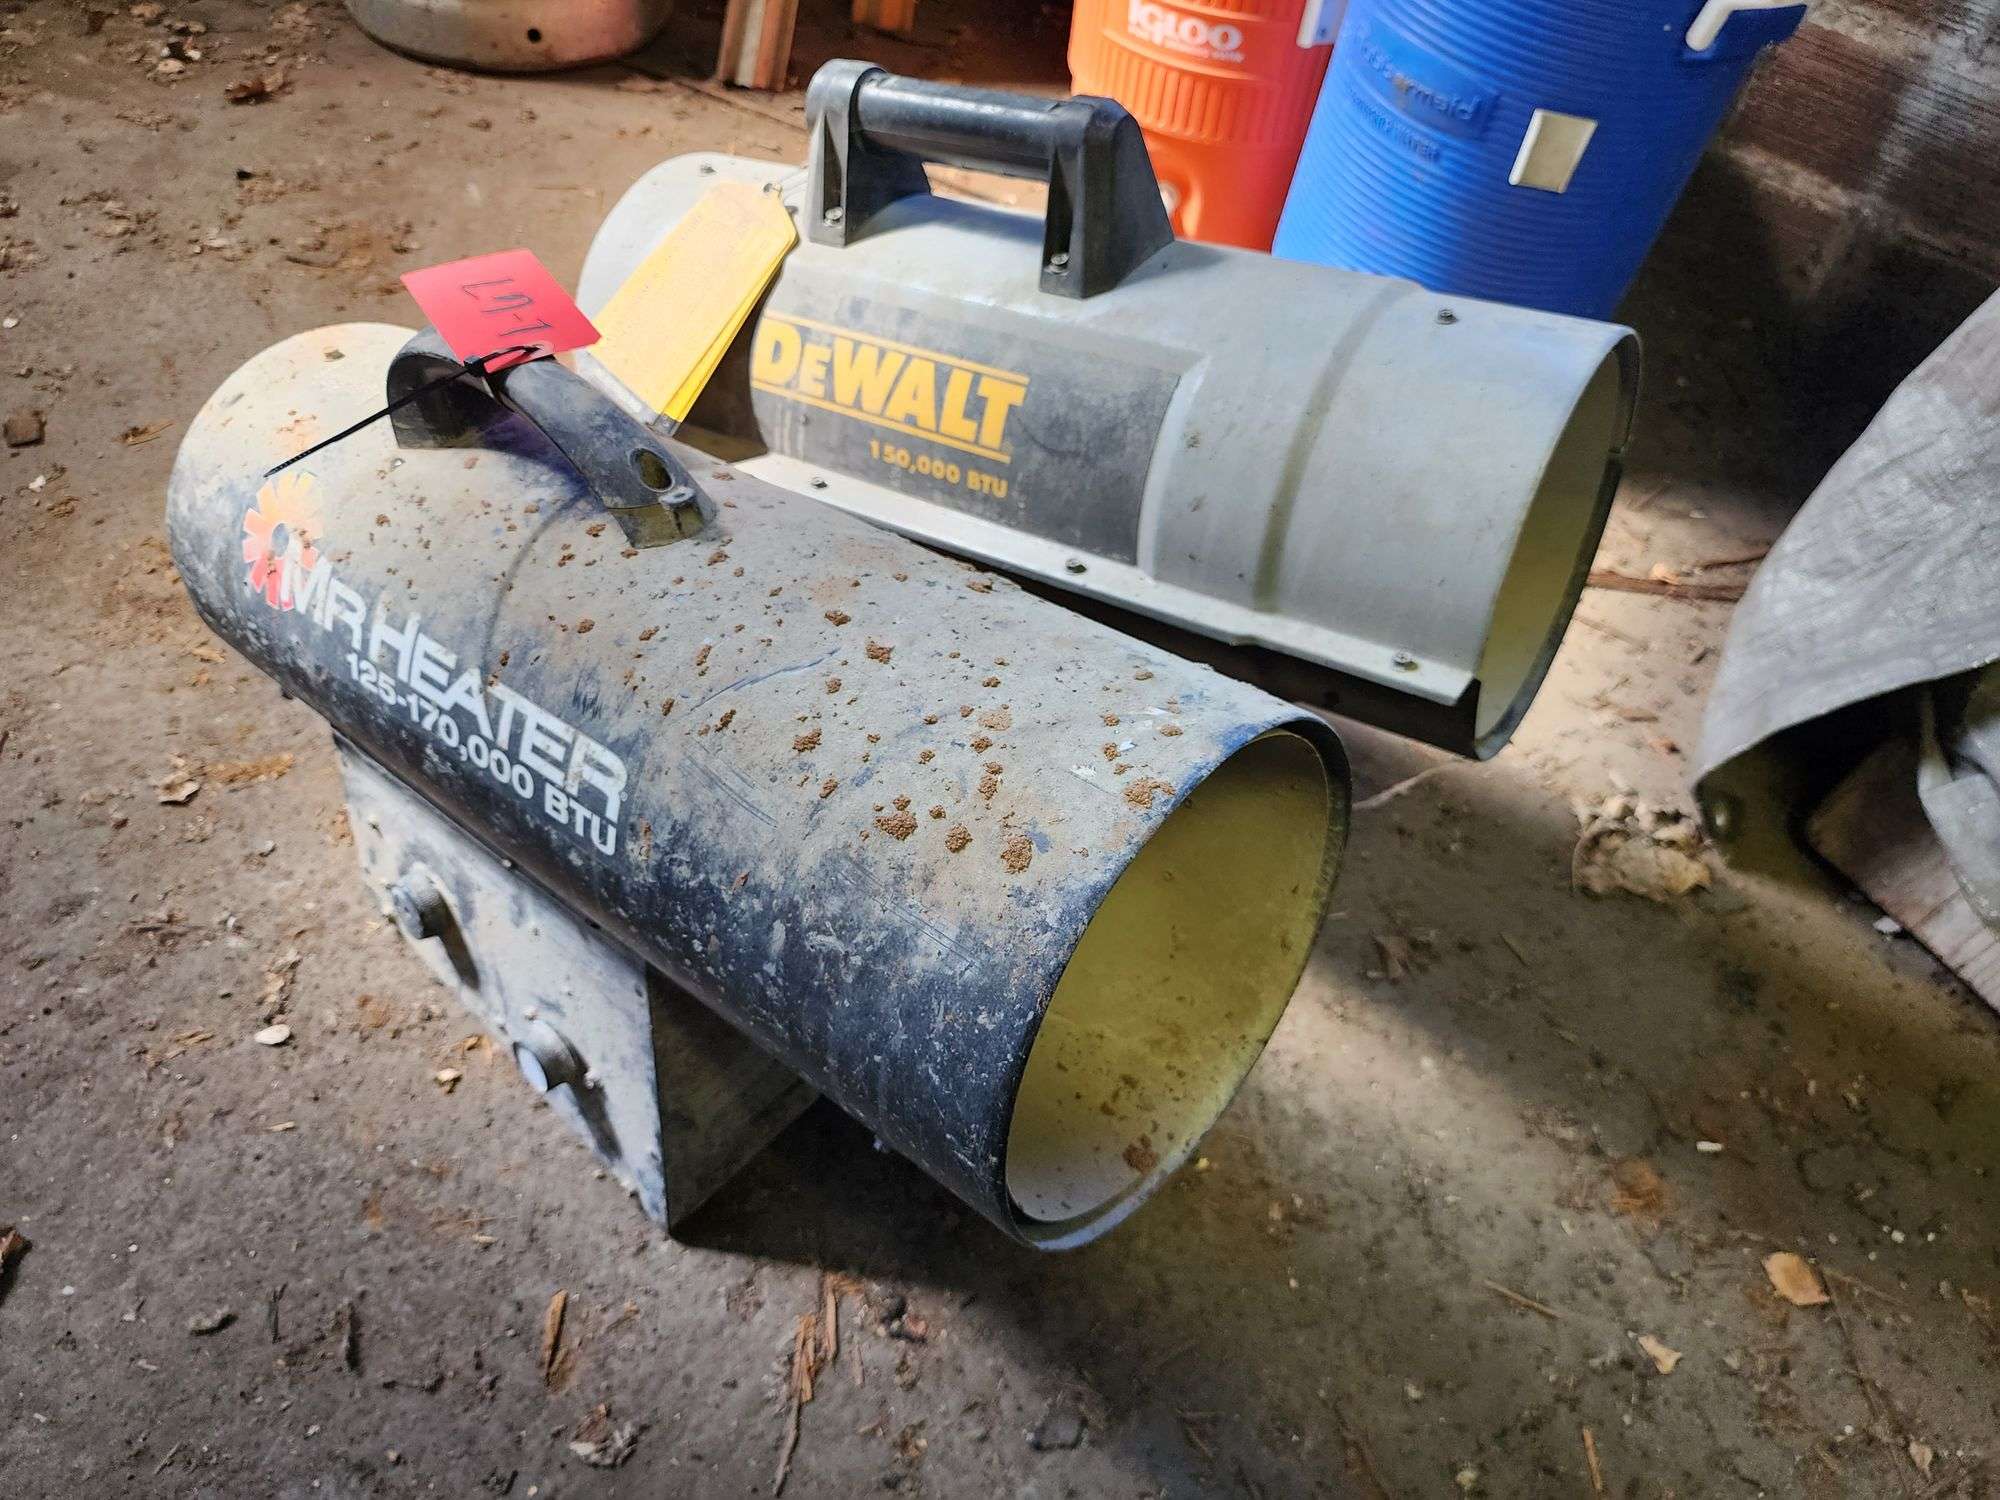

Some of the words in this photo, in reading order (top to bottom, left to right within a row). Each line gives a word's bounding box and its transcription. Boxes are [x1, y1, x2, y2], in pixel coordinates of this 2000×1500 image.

[869, 439, 961, 484] 150,000
[966, 469, 1009, 498] BTU
[346, 652, 535, 800] 125-170,000
[543, 788, 617, 856] BTU
[369, 589, 629, 824] HEATER
